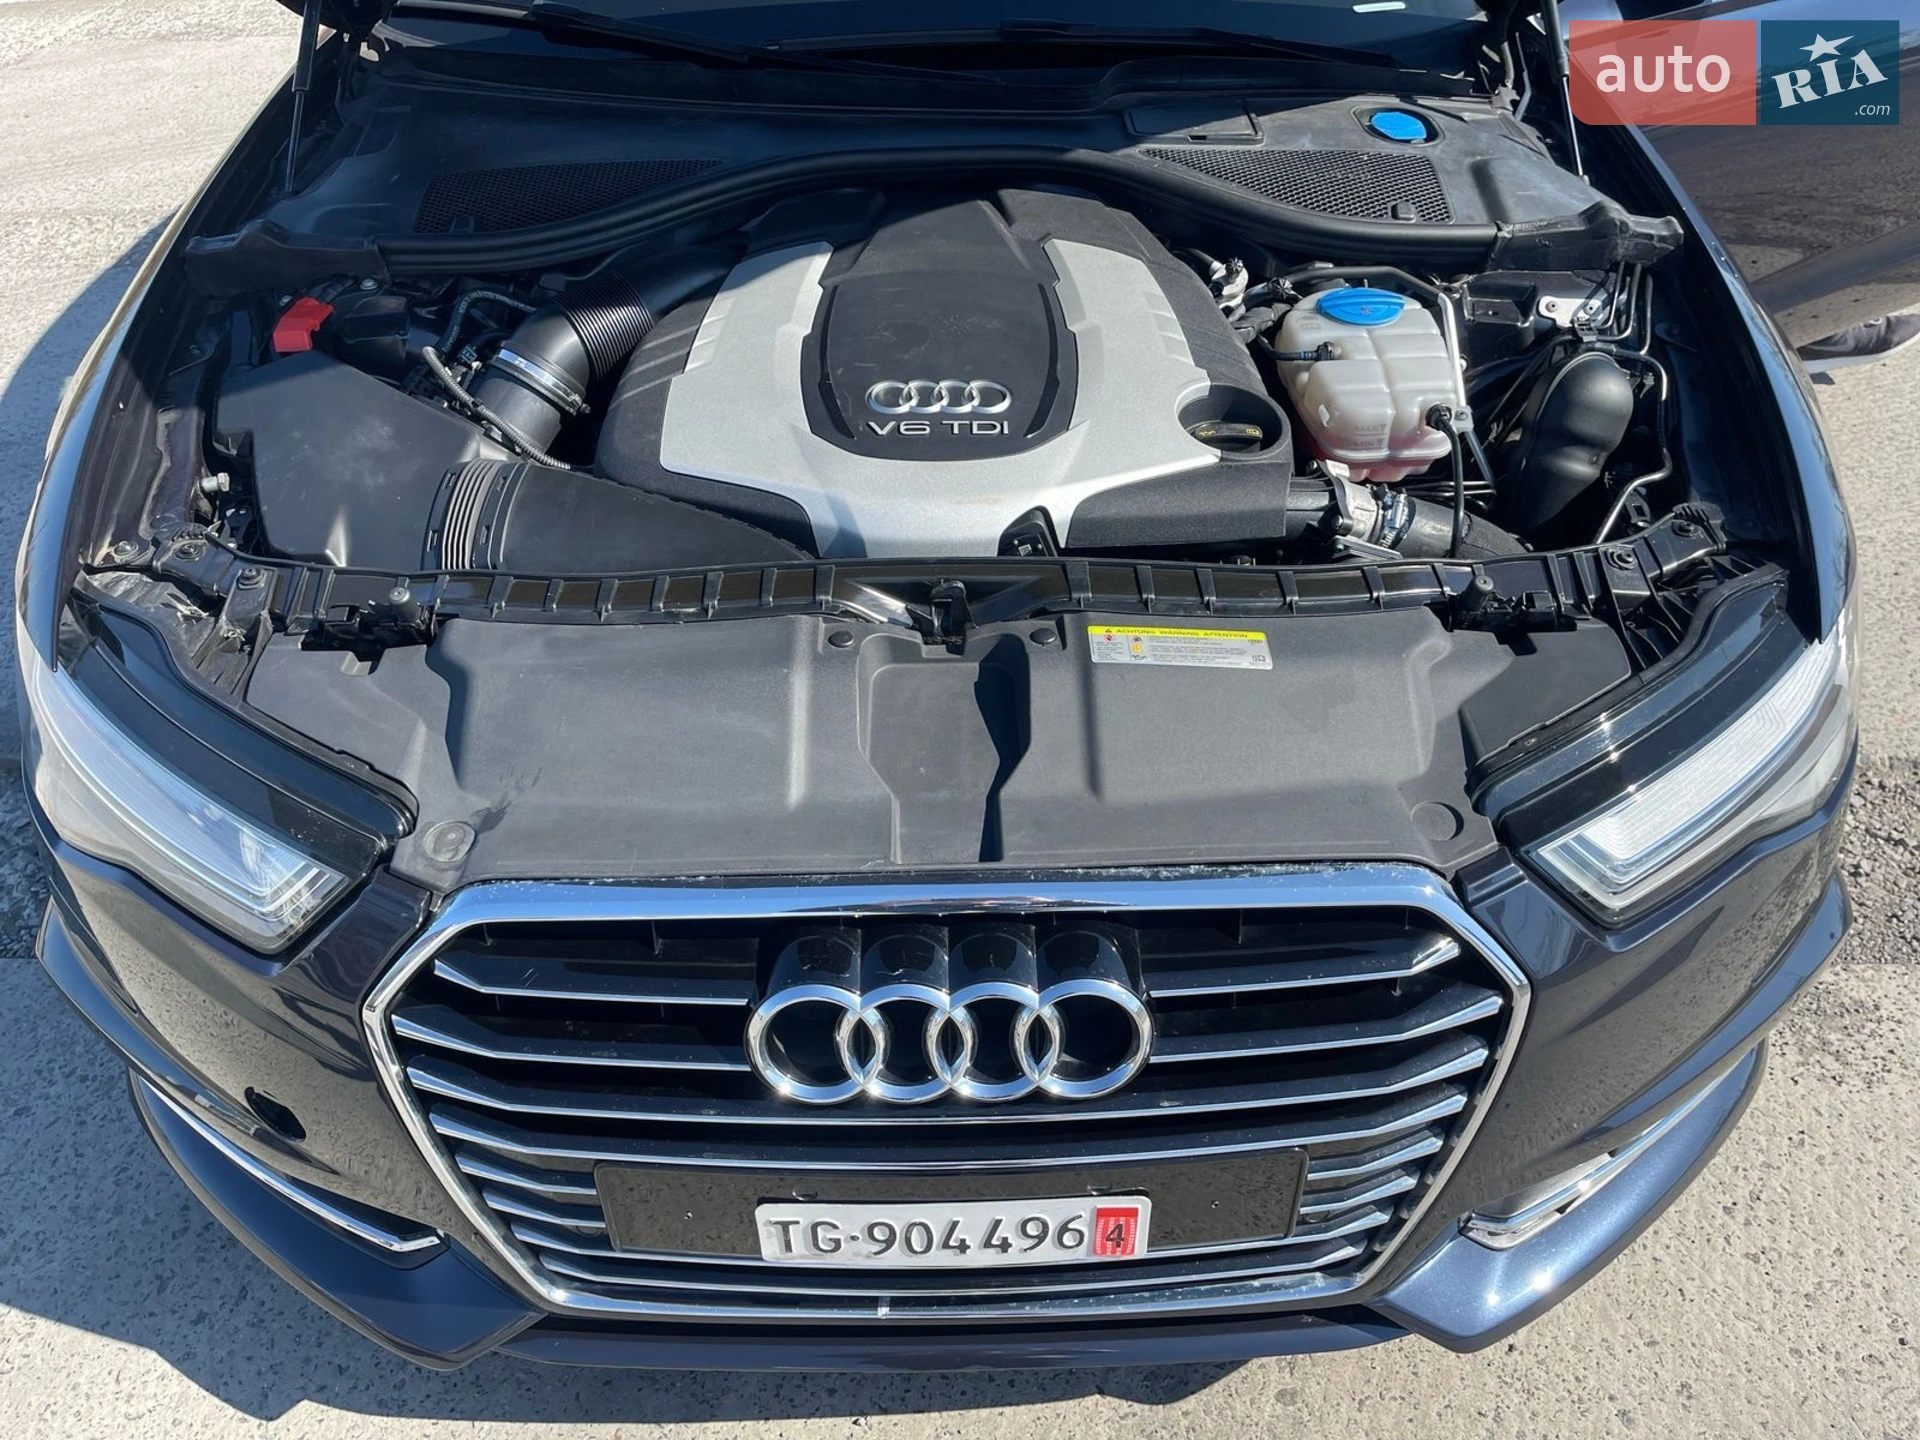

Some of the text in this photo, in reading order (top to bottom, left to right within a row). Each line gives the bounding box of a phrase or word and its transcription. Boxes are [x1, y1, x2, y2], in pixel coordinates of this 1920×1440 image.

[867, 420, 1009, 436] V6 TDI
[1159, 629, 1200, 637] WARNING
[1203, 631, 1249, 639] ATTENTION
[1105, 1223, 1125, 1249] 4
